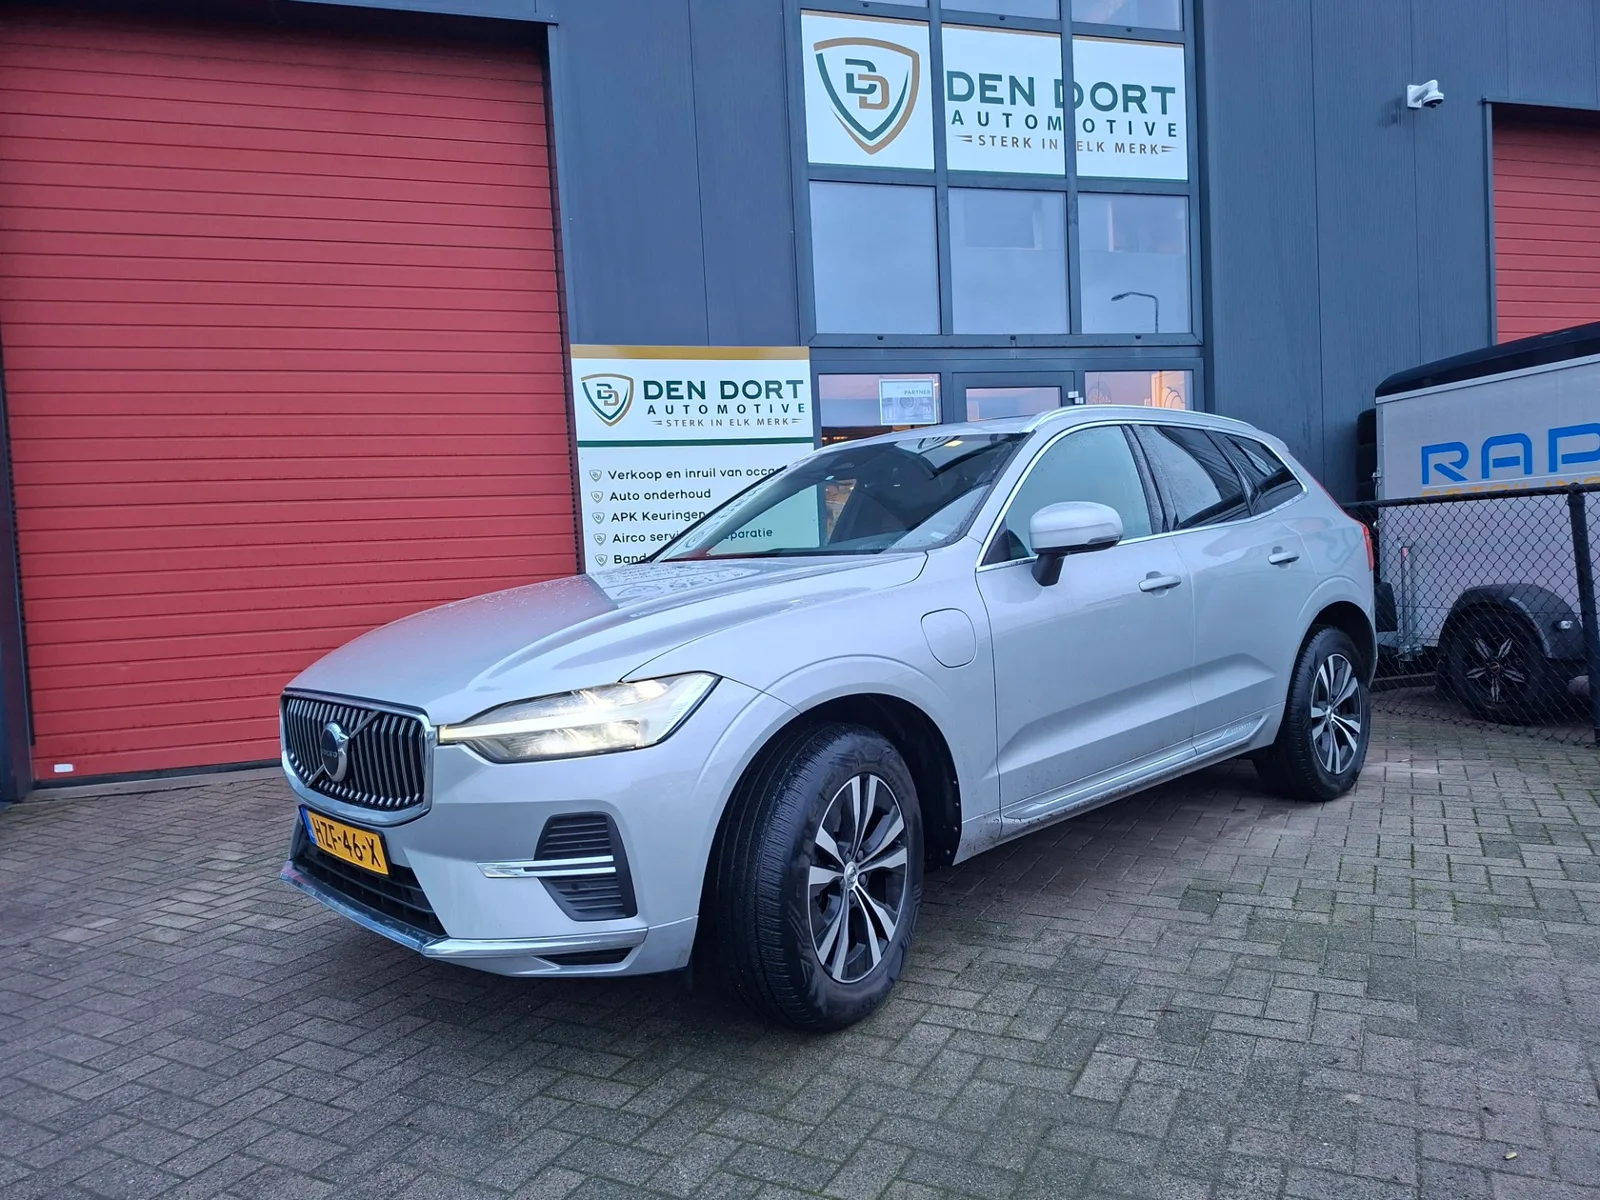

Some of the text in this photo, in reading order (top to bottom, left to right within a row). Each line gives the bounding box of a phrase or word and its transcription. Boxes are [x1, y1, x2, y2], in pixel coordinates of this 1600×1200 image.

[946, 70, 1176, 116] DEN DORT
[951, 109, 1177, 138] AUTOMOTIVE
[978, 134, 1159, 155] STERK IN ELK MERK
[643, 379, 804, 400] DEN DORT
[647, 403, 805, 415] AUTOMOTIVE
[665, 417, 789, 428] STERK IN ELK MERK
[1421, 422, 1600, 485] RAP
[608, 468, 777, 481] Verkoop en inruil van occa
[609, 489, 711, 501] Auto onderhoud
[611, 510, 706, 522] APK Keuringen
[612, 533, 646, 544] Airco
[724, 528, 773, 541] paratie
